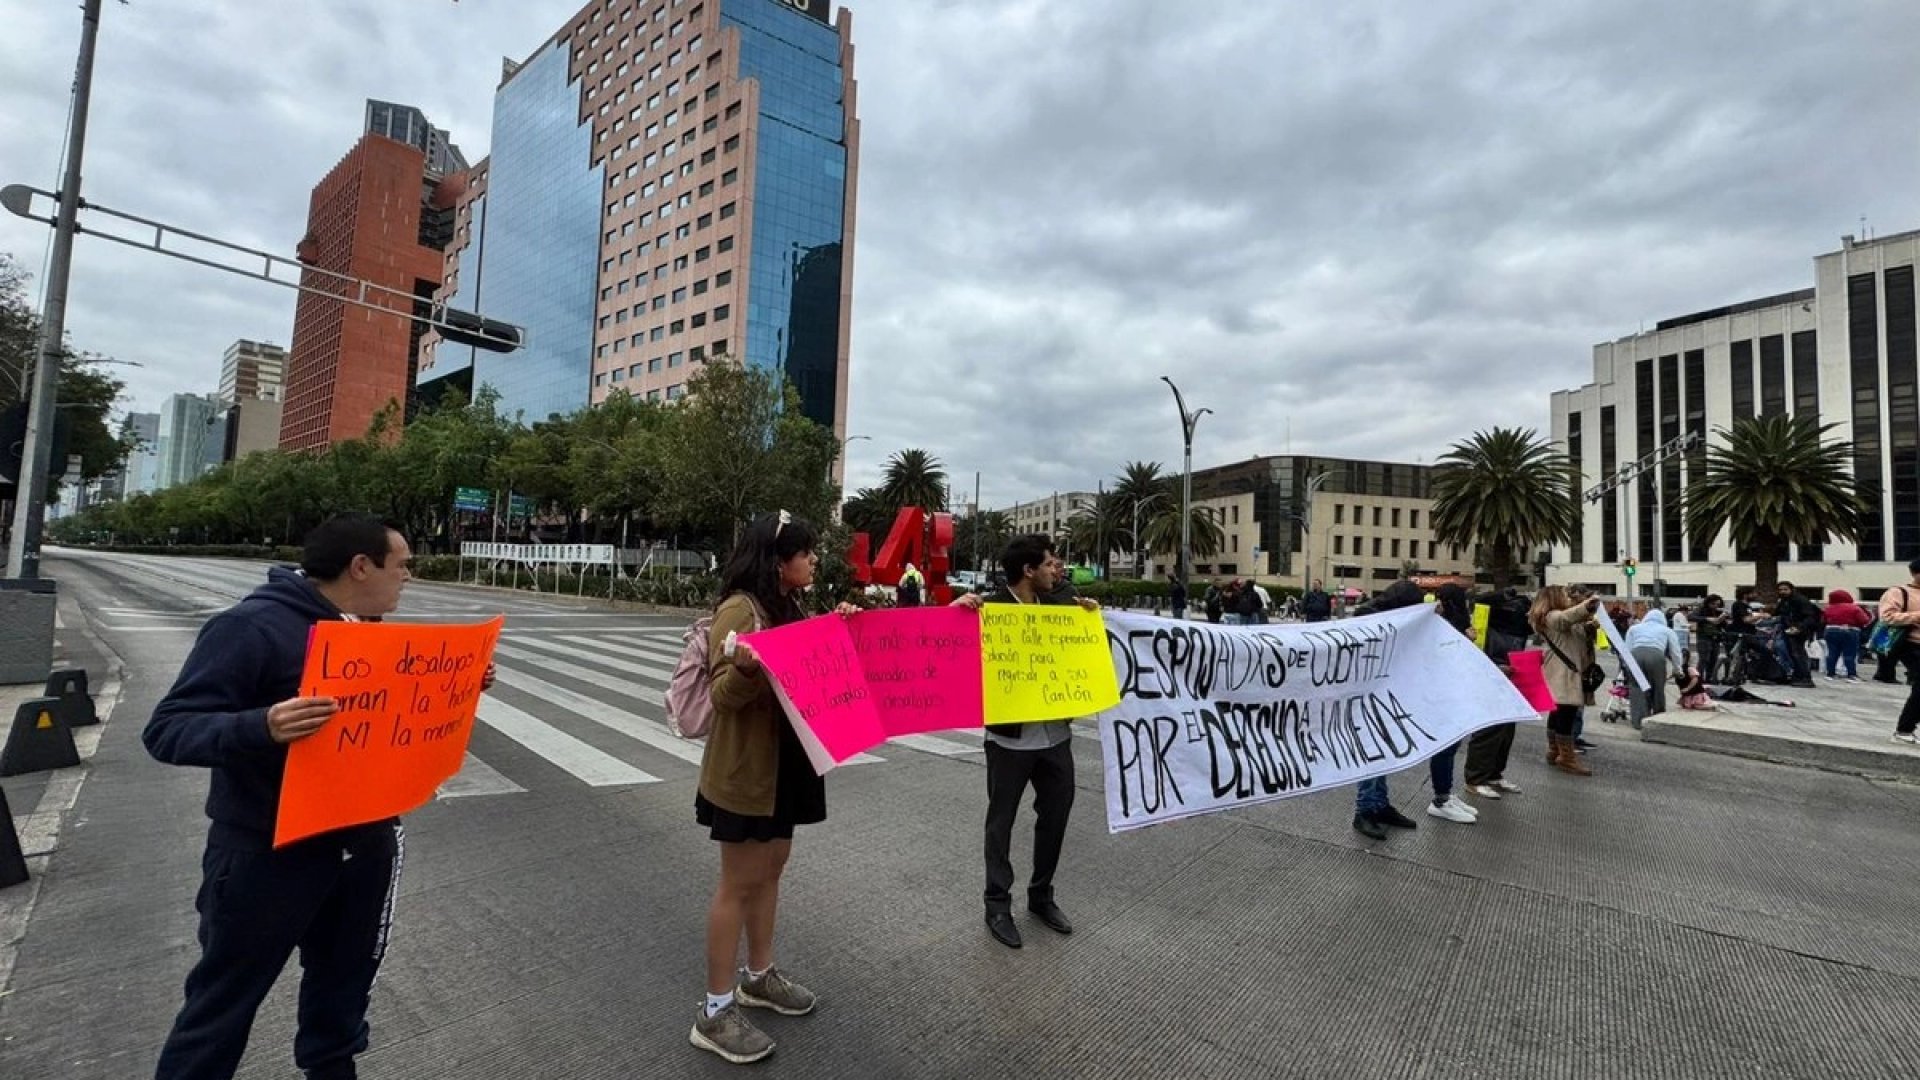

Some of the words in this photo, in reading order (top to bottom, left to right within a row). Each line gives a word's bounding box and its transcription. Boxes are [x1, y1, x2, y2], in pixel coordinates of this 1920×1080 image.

[1000, 627, 1010, 643] la
[322, 640, 372, 680] Los
[395, 640, 474, 692] desalojos
[1029, 651, 1056, 671] para
[1288, 648, 1309, 668] DE
[1049, 670, 1058, 681] a
[312, 687, 388, 713] rran
[410, 681, 431, 715] la
[390, 713, 412, 747] la
[1114, 716, 1184, 809] POR
[1181, 709, 1207, 744] EL
[1200, 699, 1312, 799] DERECHO
